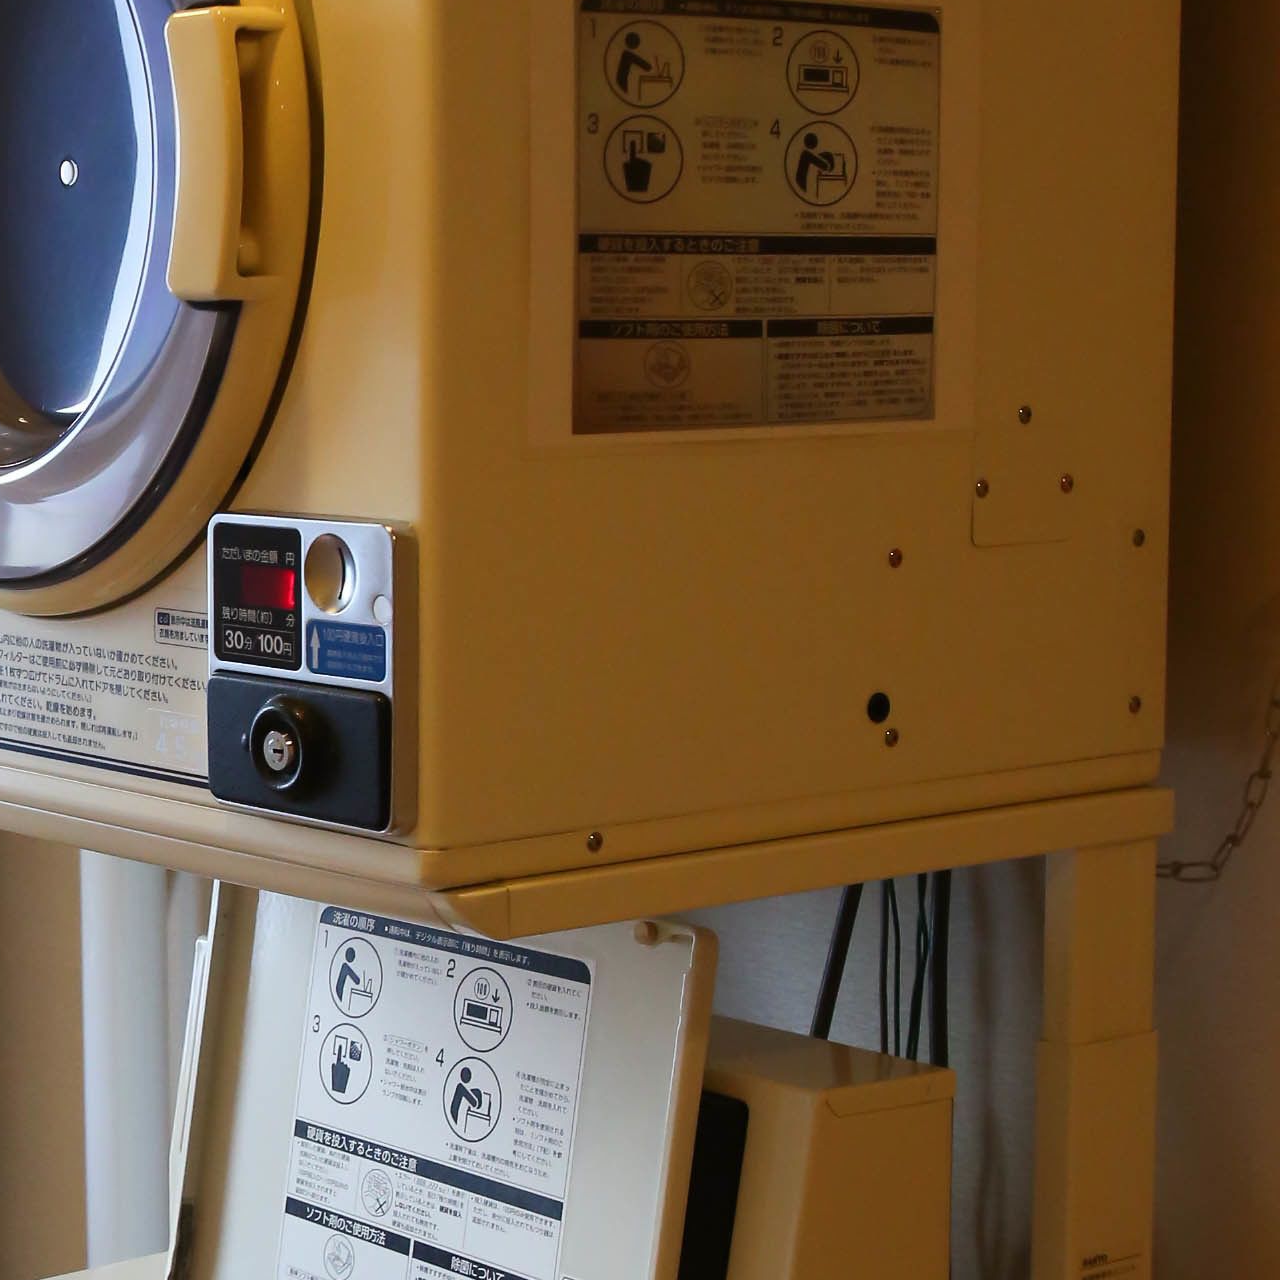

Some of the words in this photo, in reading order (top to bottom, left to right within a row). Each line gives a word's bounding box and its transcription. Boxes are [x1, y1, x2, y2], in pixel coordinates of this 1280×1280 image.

[333, 910, 375, 932] 洗濯の順序
[324, 929, 329, 948] 1
[446, 958, 456, 978] 2
[312, 1014, 320, 1033] 3
[435, 1048, 444, 1067] 4
[306, 1125, 417, 1173] 硬貨を投入するときのご注意
[306, 1206, 387, 1246] ソフト剤のご使用方法
